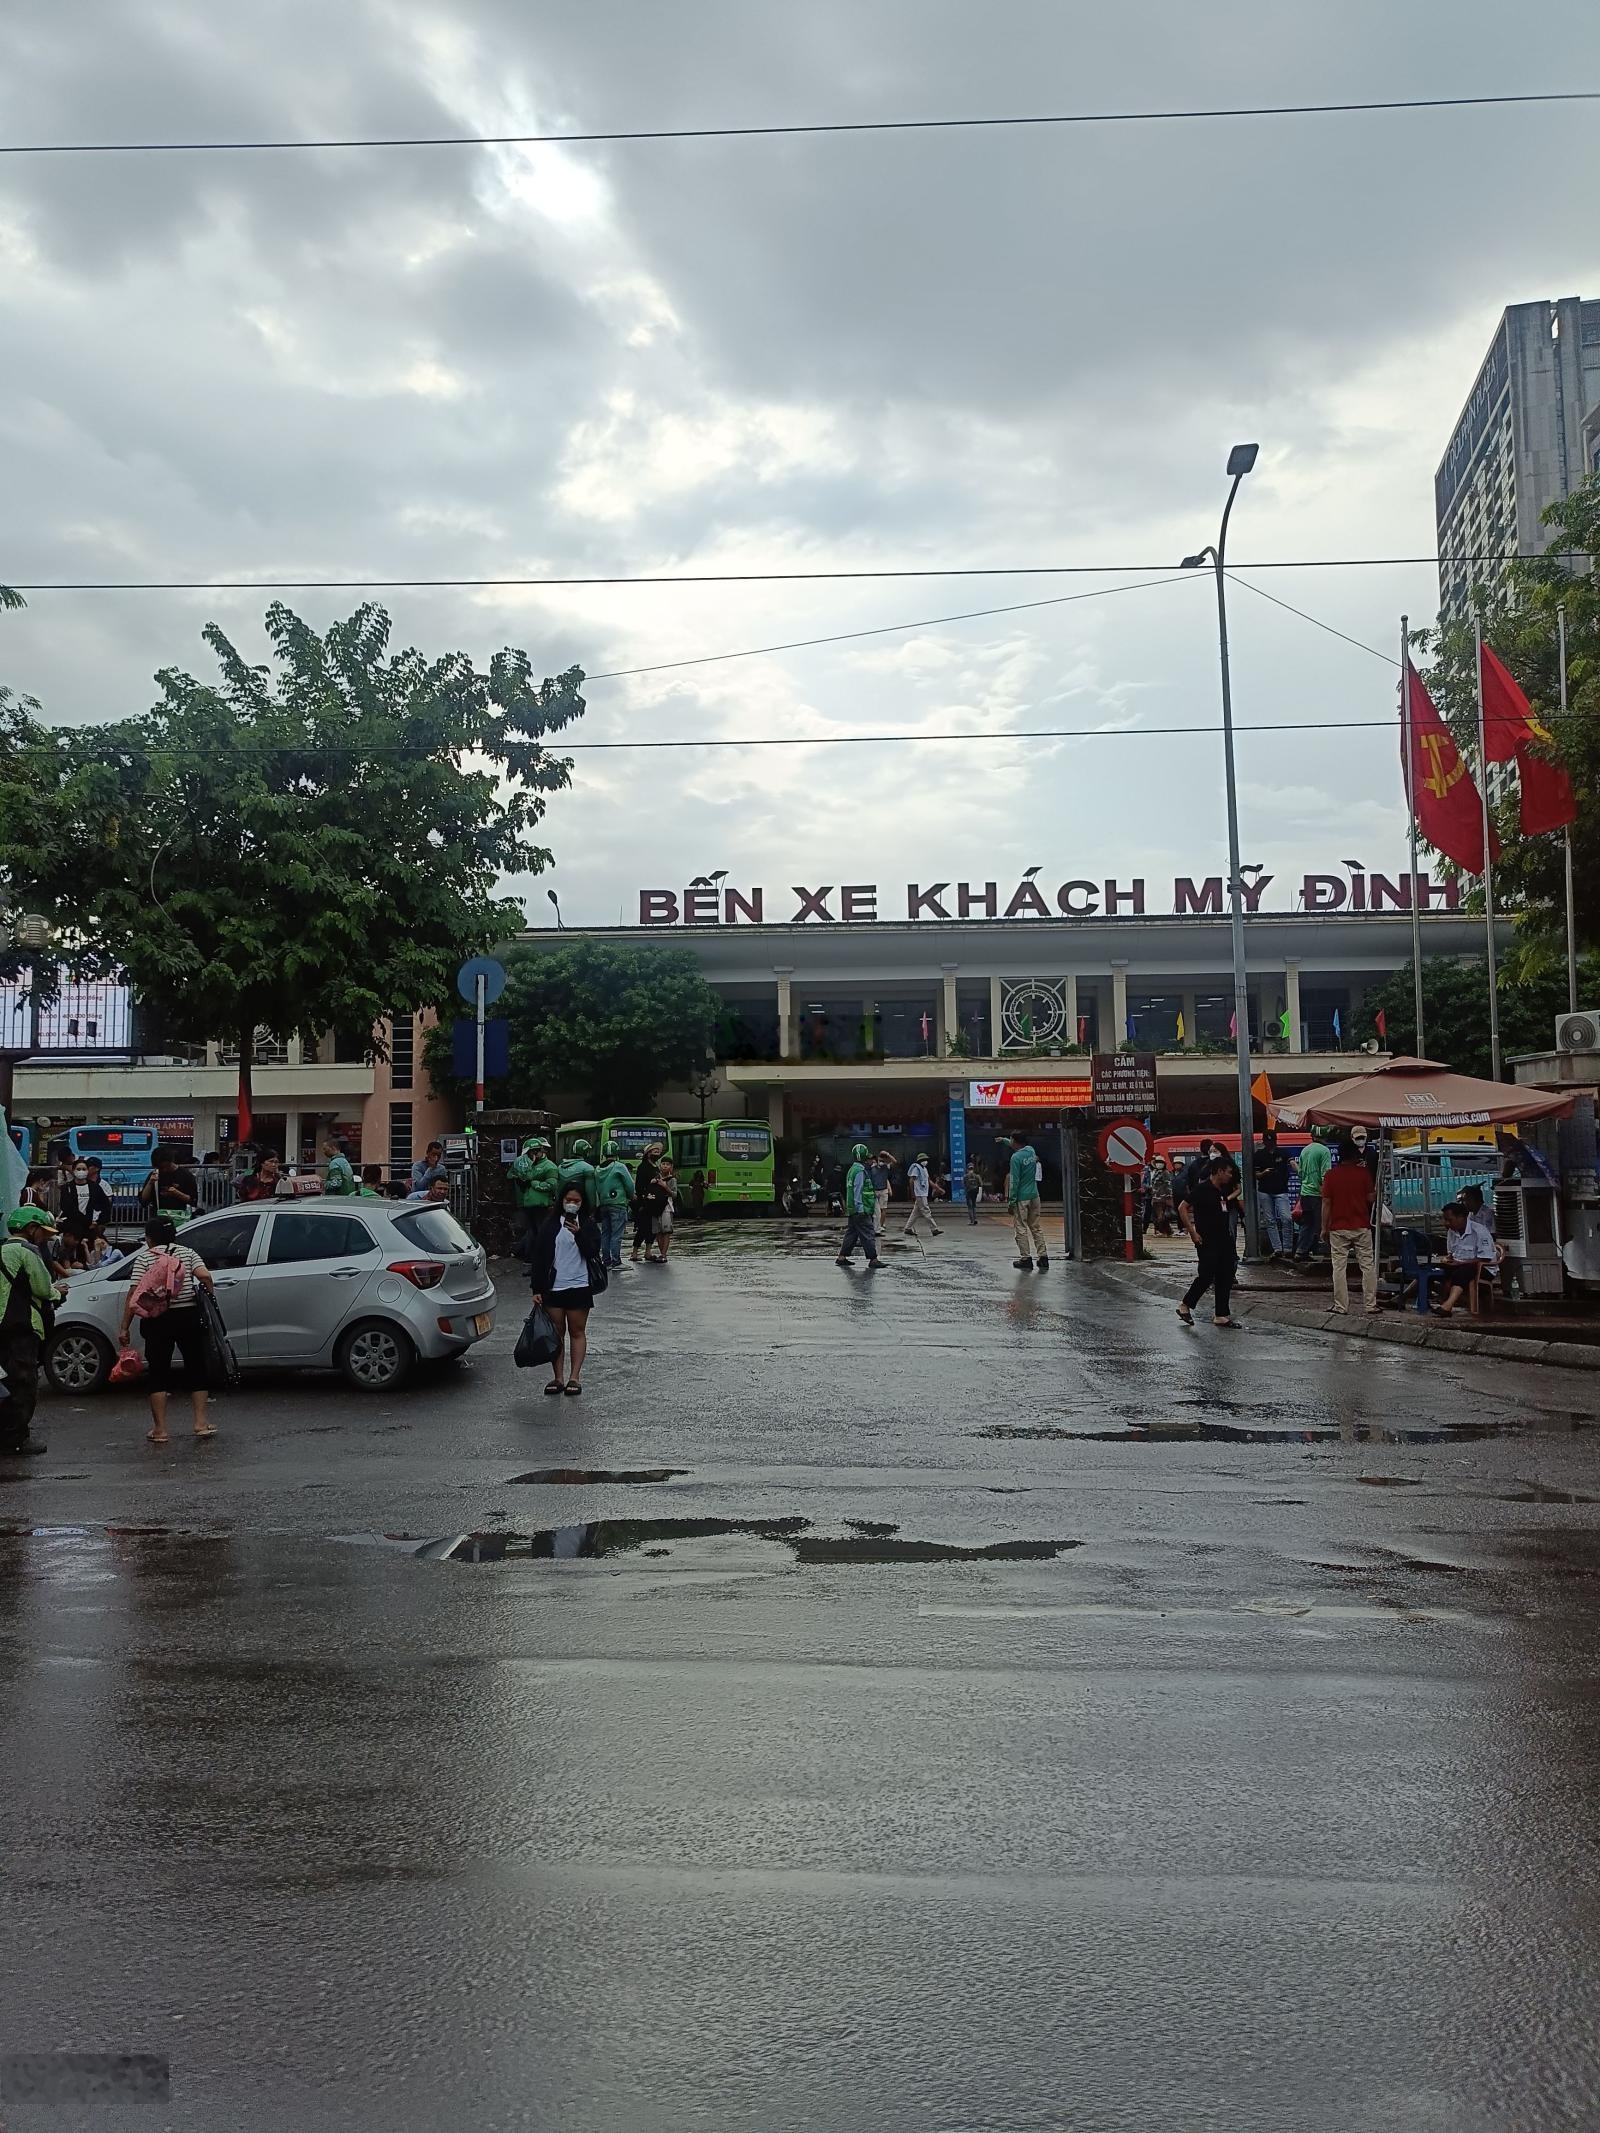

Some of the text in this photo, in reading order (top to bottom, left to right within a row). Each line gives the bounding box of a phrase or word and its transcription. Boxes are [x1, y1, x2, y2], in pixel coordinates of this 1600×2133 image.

[640, 860, 1459, 924] BẾN XE KHÁCH MỸ ĐÌNH
[1114, 1053, 1135, 1067] CẤM
